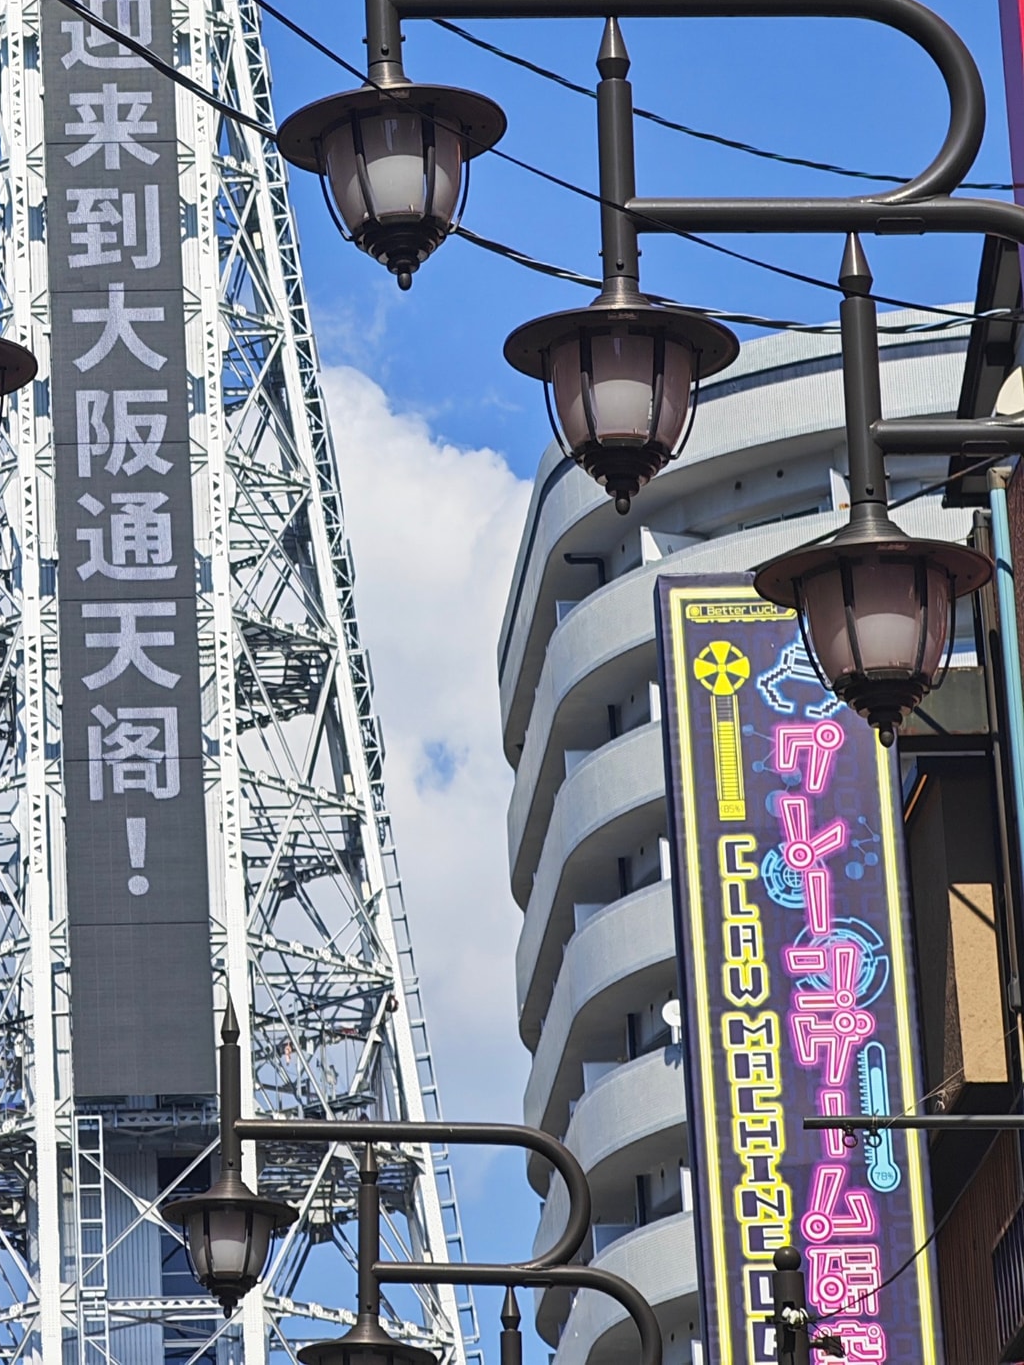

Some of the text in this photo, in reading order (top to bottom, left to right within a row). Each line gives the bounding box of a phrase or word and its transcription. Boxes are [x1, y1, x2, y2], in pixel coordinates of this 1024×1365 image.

[706, 604, 778, 616] Better Luck
[721, 837, 767, 1003] CLAW
[725, 1013, 789, 1256] MACHINE
